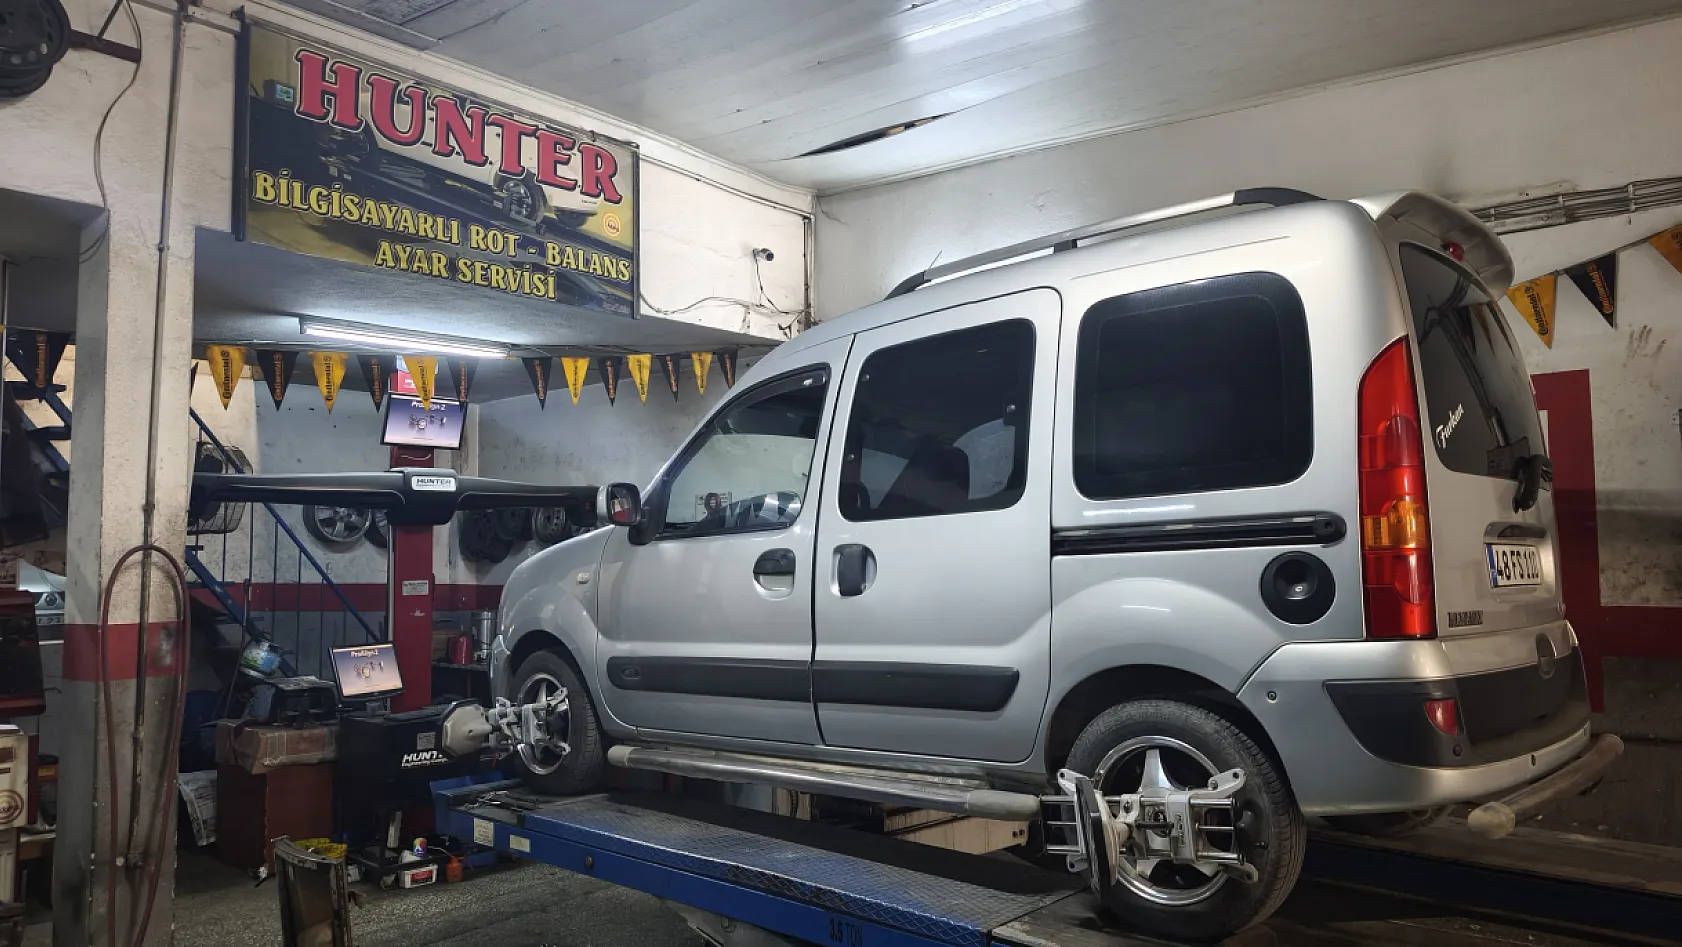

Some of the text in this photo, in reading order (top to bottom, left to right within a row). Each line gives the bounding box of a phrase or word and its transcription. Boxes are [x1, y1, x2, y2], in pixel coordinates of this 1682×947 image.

[296, 50, 623, 204] HUNTER
[253, 168, 460, 244] BİLGİSAYARLI
[469, 223, 521, 258] ROT
[545, 240, 632, 283] BALANS
[375, 240, 557, 300] AYAR SERVİSİ
[36, 343, 46, 388] Continental
[222, 359, 231, 399] Continental
[274, 361, 282, 400] Continental
[325, 363, 333, 401] Continental
[419, 366, 429, 402] Continental
[402, 751, 441, 763] HUNT
